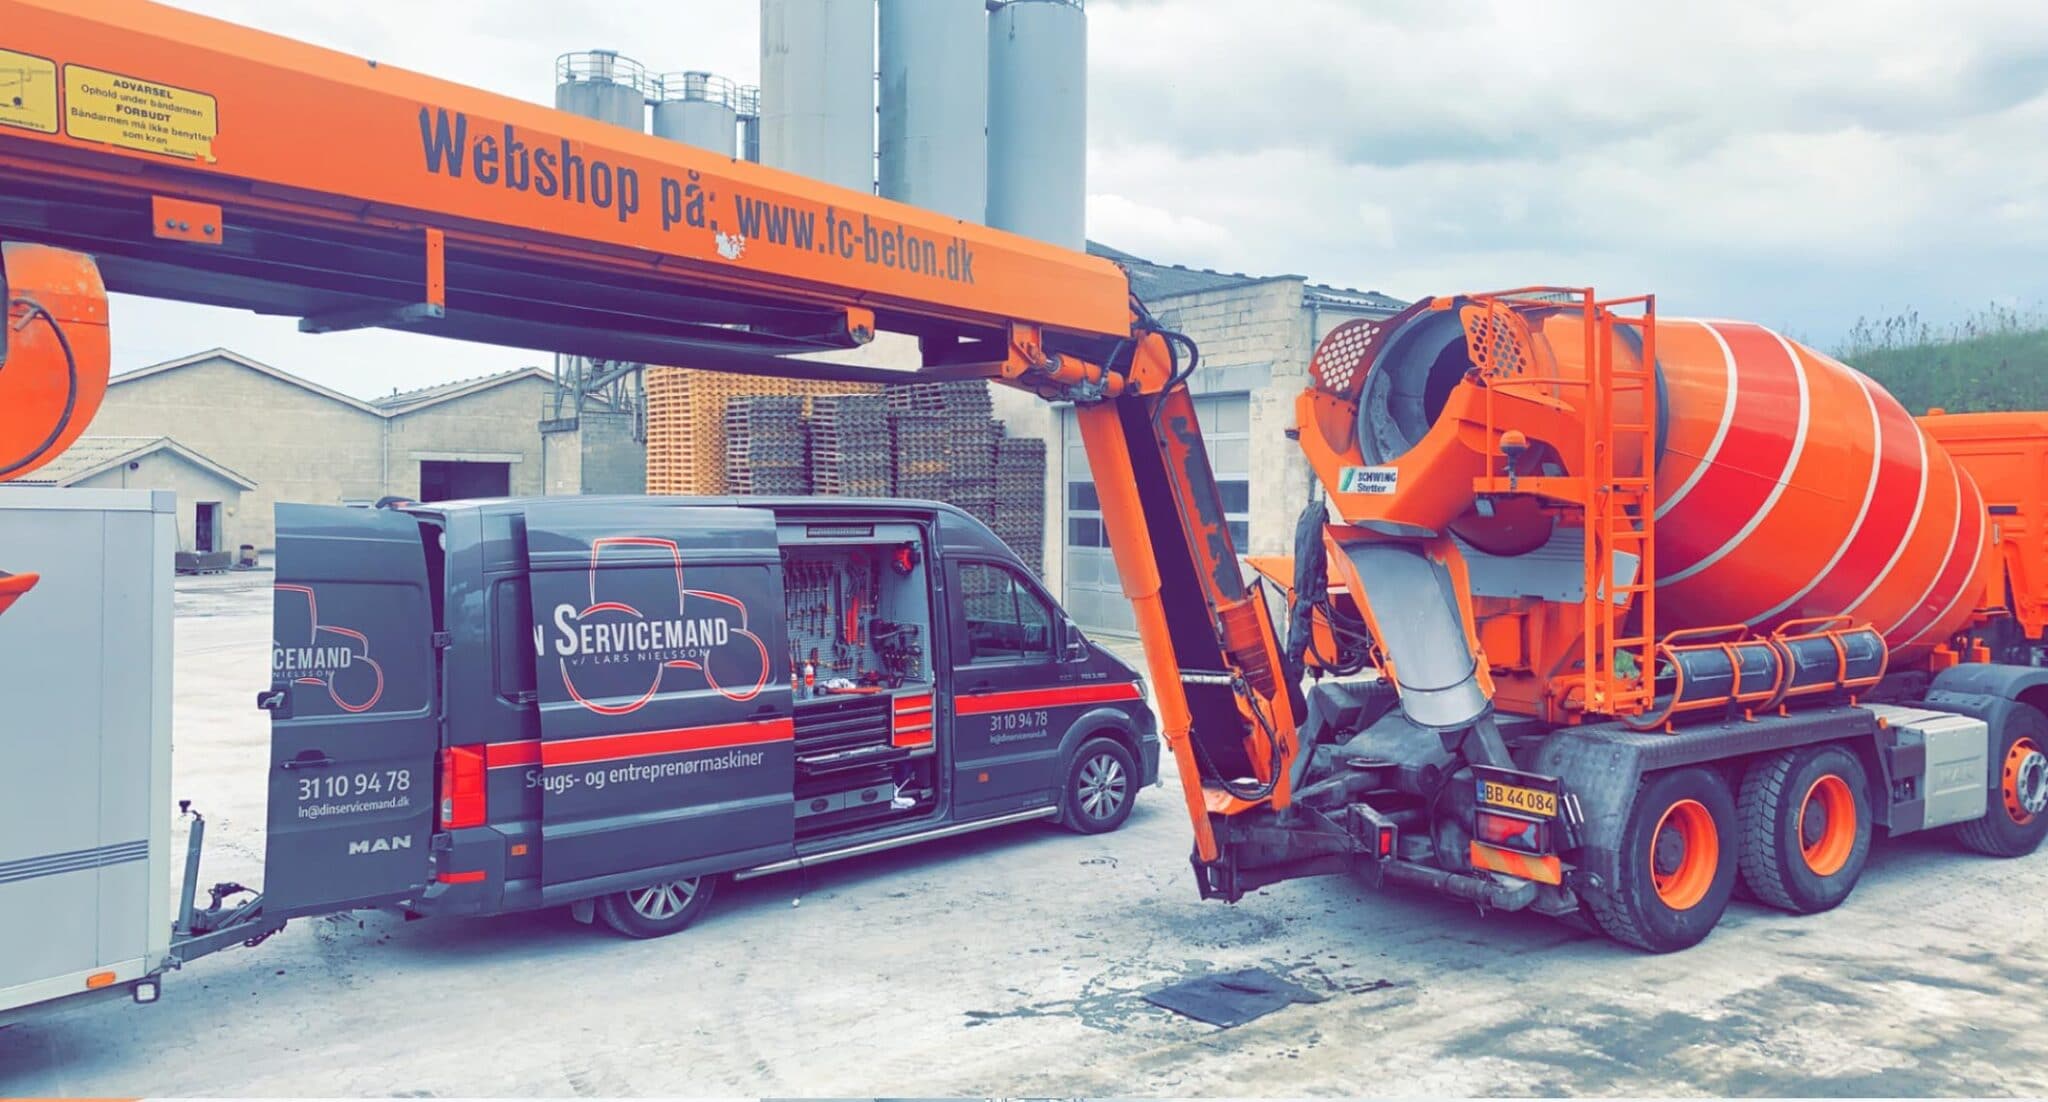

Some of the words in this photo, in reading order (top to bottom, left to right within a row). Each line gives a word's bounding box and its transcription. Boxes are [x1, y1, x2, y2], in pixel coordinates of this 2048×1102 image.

[113, 79, 174, 100] ADVARSEL
[81, 84, 118, 100] Ophold
[119, 94, 148, 105] under
[149, 99, 204, 117] båndarmen
[71, 107, 129, 126] Båndarmen
[130, 118, 147, 131] må
[149, 123, 170, 135] ikke
[116, 103, 172, 123] FORBUDT
[122, 130, 145, 141] som
[145, 133, 168, 145] kran
[418, 106, 639, 213] Webshop
[660, 168, 718, 232] på:
[1358, 471, 1396, 482] SCHWING
[1357, 482, 1387, 493] Stetter
[272, 647, 351, 670] CEMAND
[594, 652, 630, 665] LARS
[638, 648, 706, 661] NIELSSON
[990, 715, 1002, 731] 31
[1004, 713, 1016, 729] 10
[1018, 712, 1032, 728] 94
[1035, 711, 1048, 726] 78
[585, 770, 605, 789] og
[609, 751, 764, 783] entreprenørmaskiner
[298, 778, 320, 800] 31
[325, 775, 349, 798] 10
[354, 772, 381, 795] 94
[386, 769, 410, 791] 78
[1486, 784, 1503, 802] BB
[1507, 789, 1524, 806] 44
[1527, 792, 1553, 812] 084
[348, 834, 411, 855] MAN
